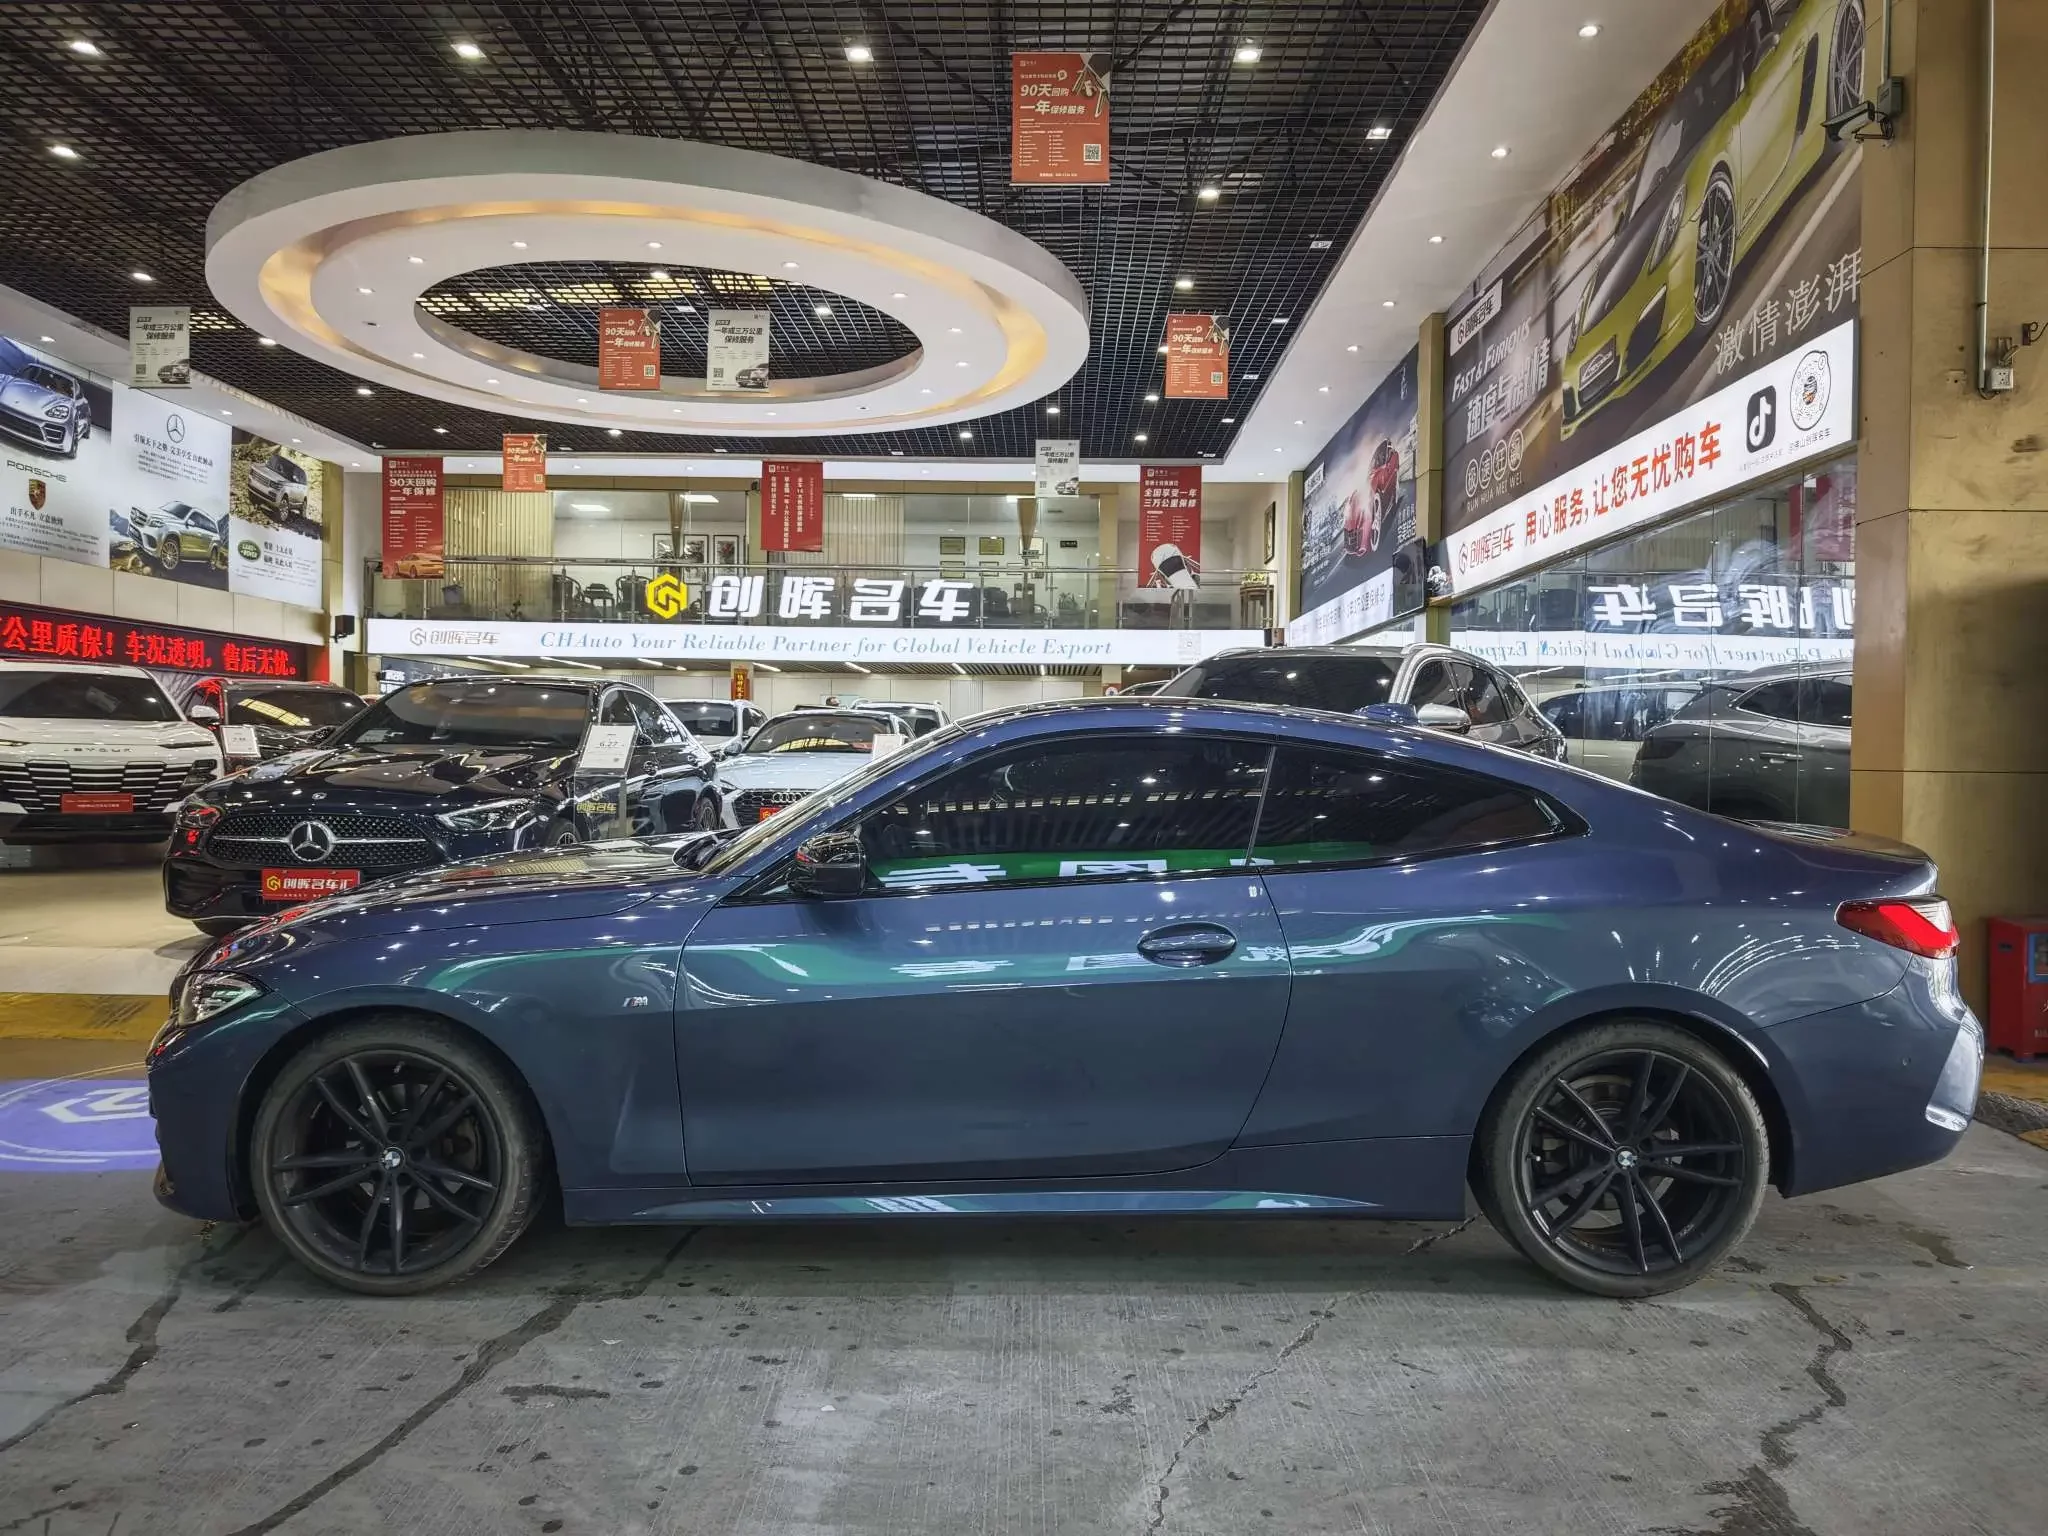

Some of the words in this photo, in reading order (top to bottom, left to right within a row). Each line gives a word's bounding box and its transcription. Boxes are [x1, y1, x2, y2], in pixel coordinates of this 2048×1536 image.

[1452, 367, 1476, 403] FAST
[1483, 316, 1532, 375] FURIOUS
[6, 459, 68, 483] PORSCHE
[708, 575, 974, 622] 创晖名车
[631, 632, 677, 650] Your
[683, 633, 766, 652] Reliable
[772, 635, 853, 653] Partner
[853, 637, 888, 658] for
[893, 637, 961, 654] Global
[967, 638, 1037, 655] Vehicle
[1043, 638, 1113, 660] Export
